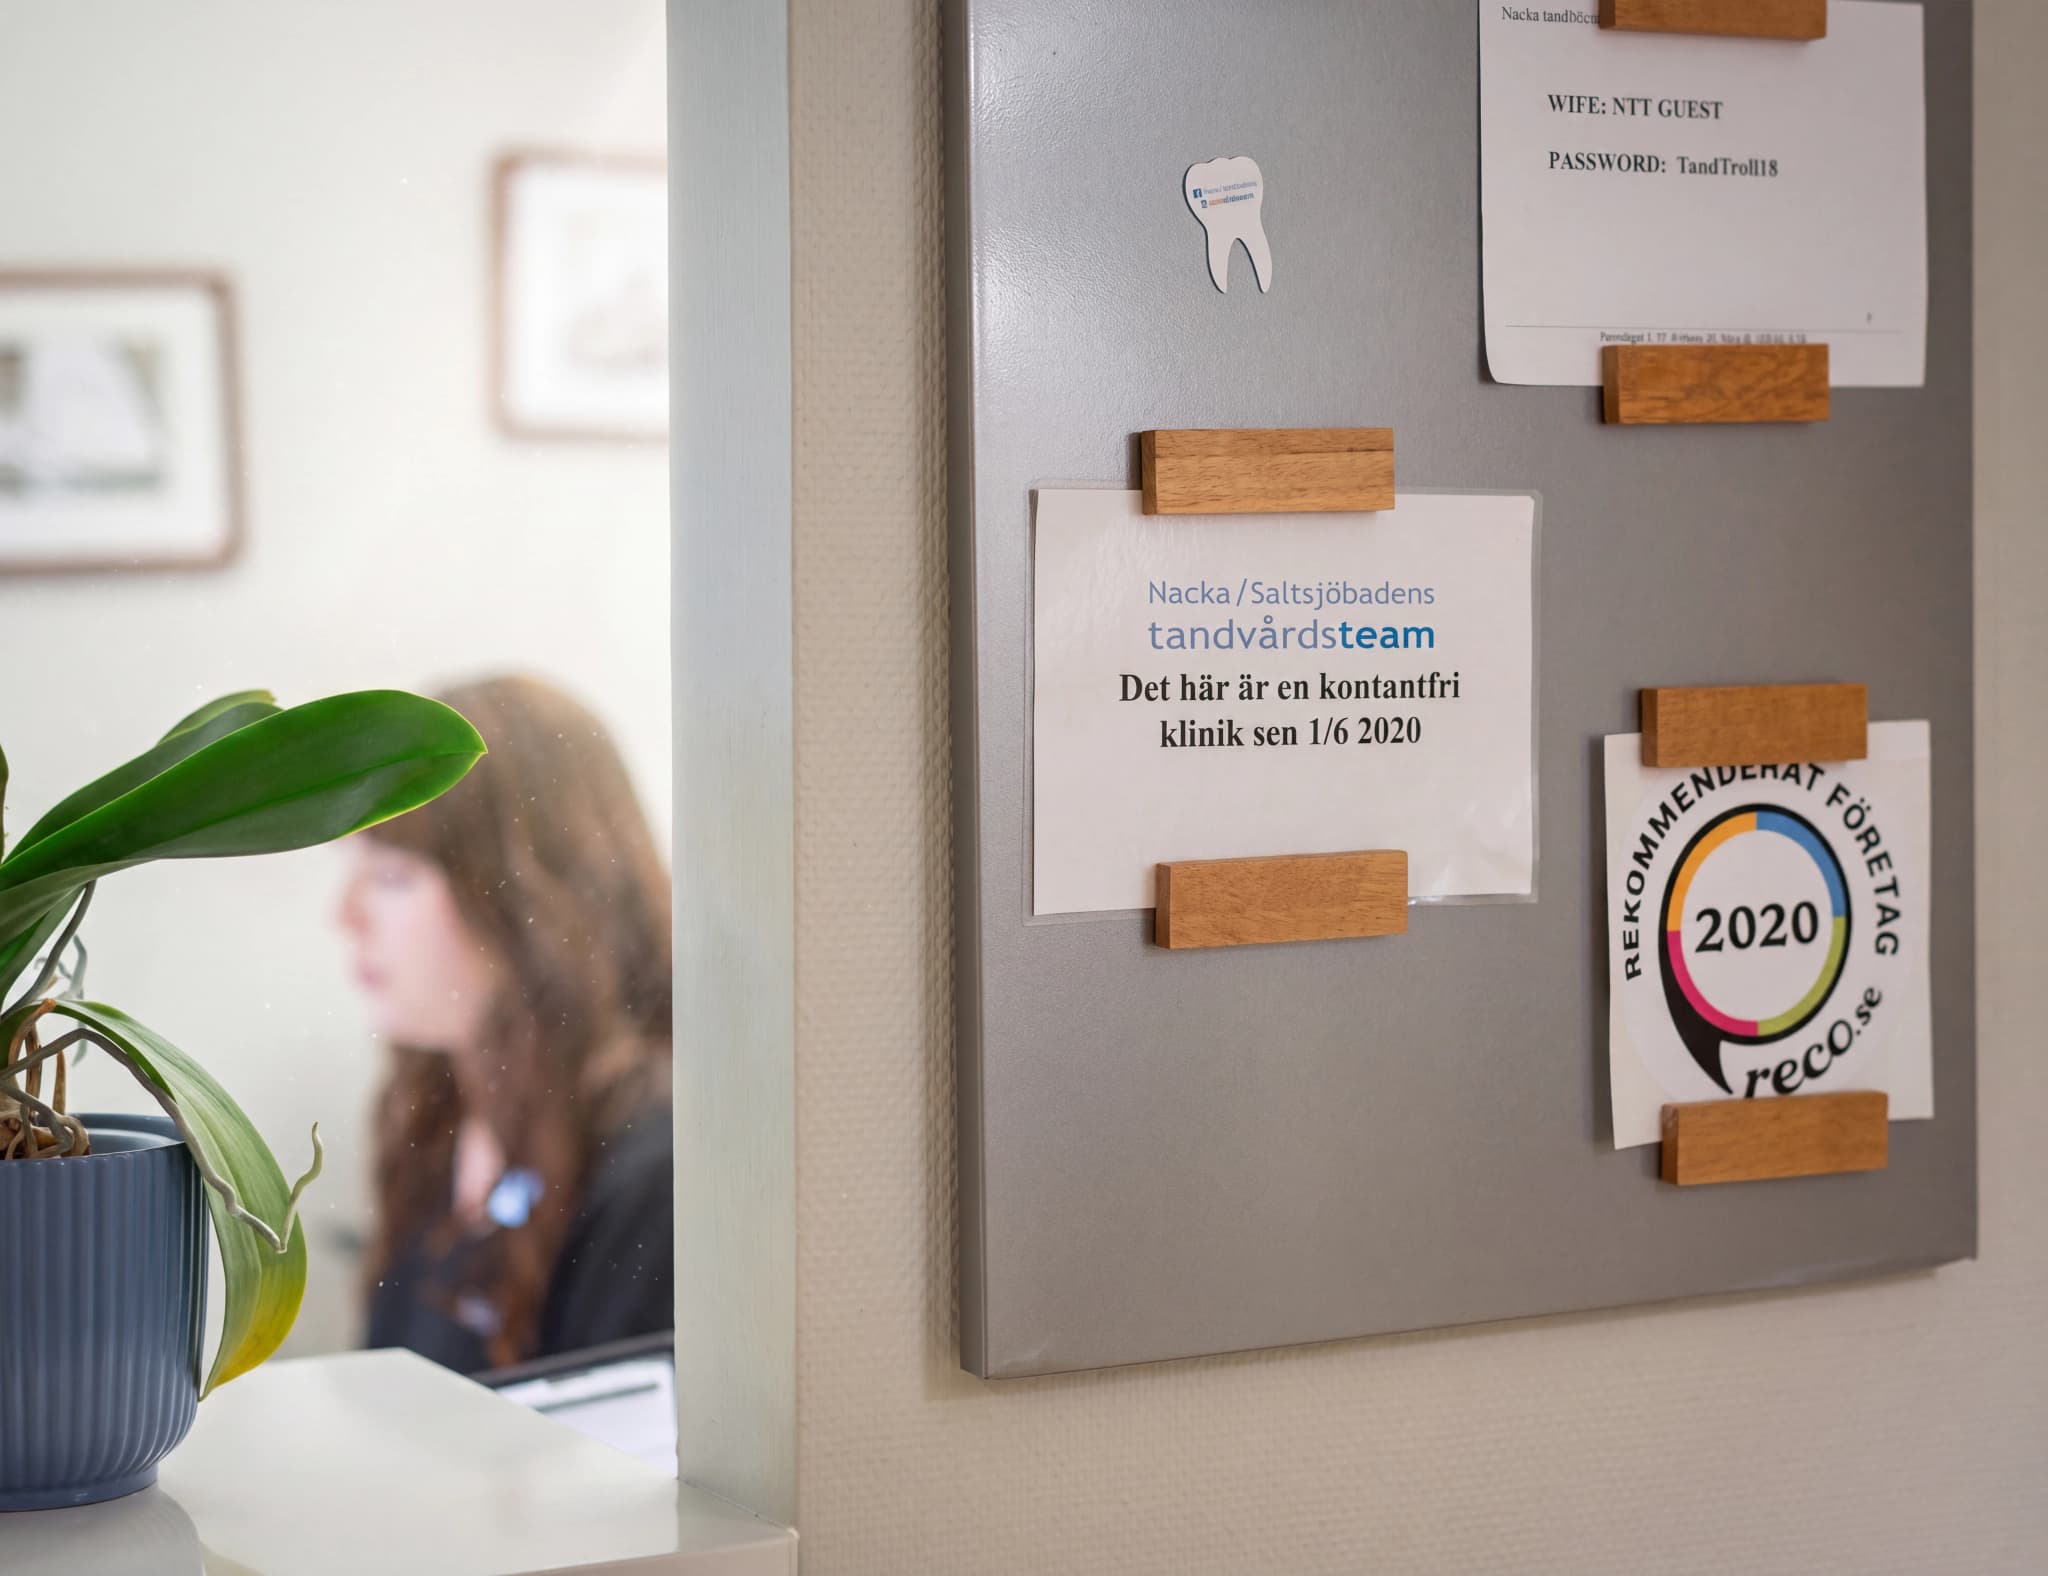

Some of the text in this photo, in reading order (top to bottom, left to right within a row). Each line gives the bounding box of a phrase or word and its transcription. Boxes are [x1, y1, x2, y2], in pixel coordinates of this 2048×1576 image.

[1501, 6, 1539, 22] Nacka
[1548, 94, 1724, 120] WIFE: NTT GUEST
[1549, 151, 1779, 178] PASSWORD: TandTroll18
[1148, 615, 1435, 650] tandvårdsteam
[1119, 671, 1461, 702] Det här är en kontantfri
[1160, 716, 1422, 748] klinik sen 1/6 2020
[1825, 783, 1902, 957] FÖRETAG
[1694, 900, 1819, 954] 2020
